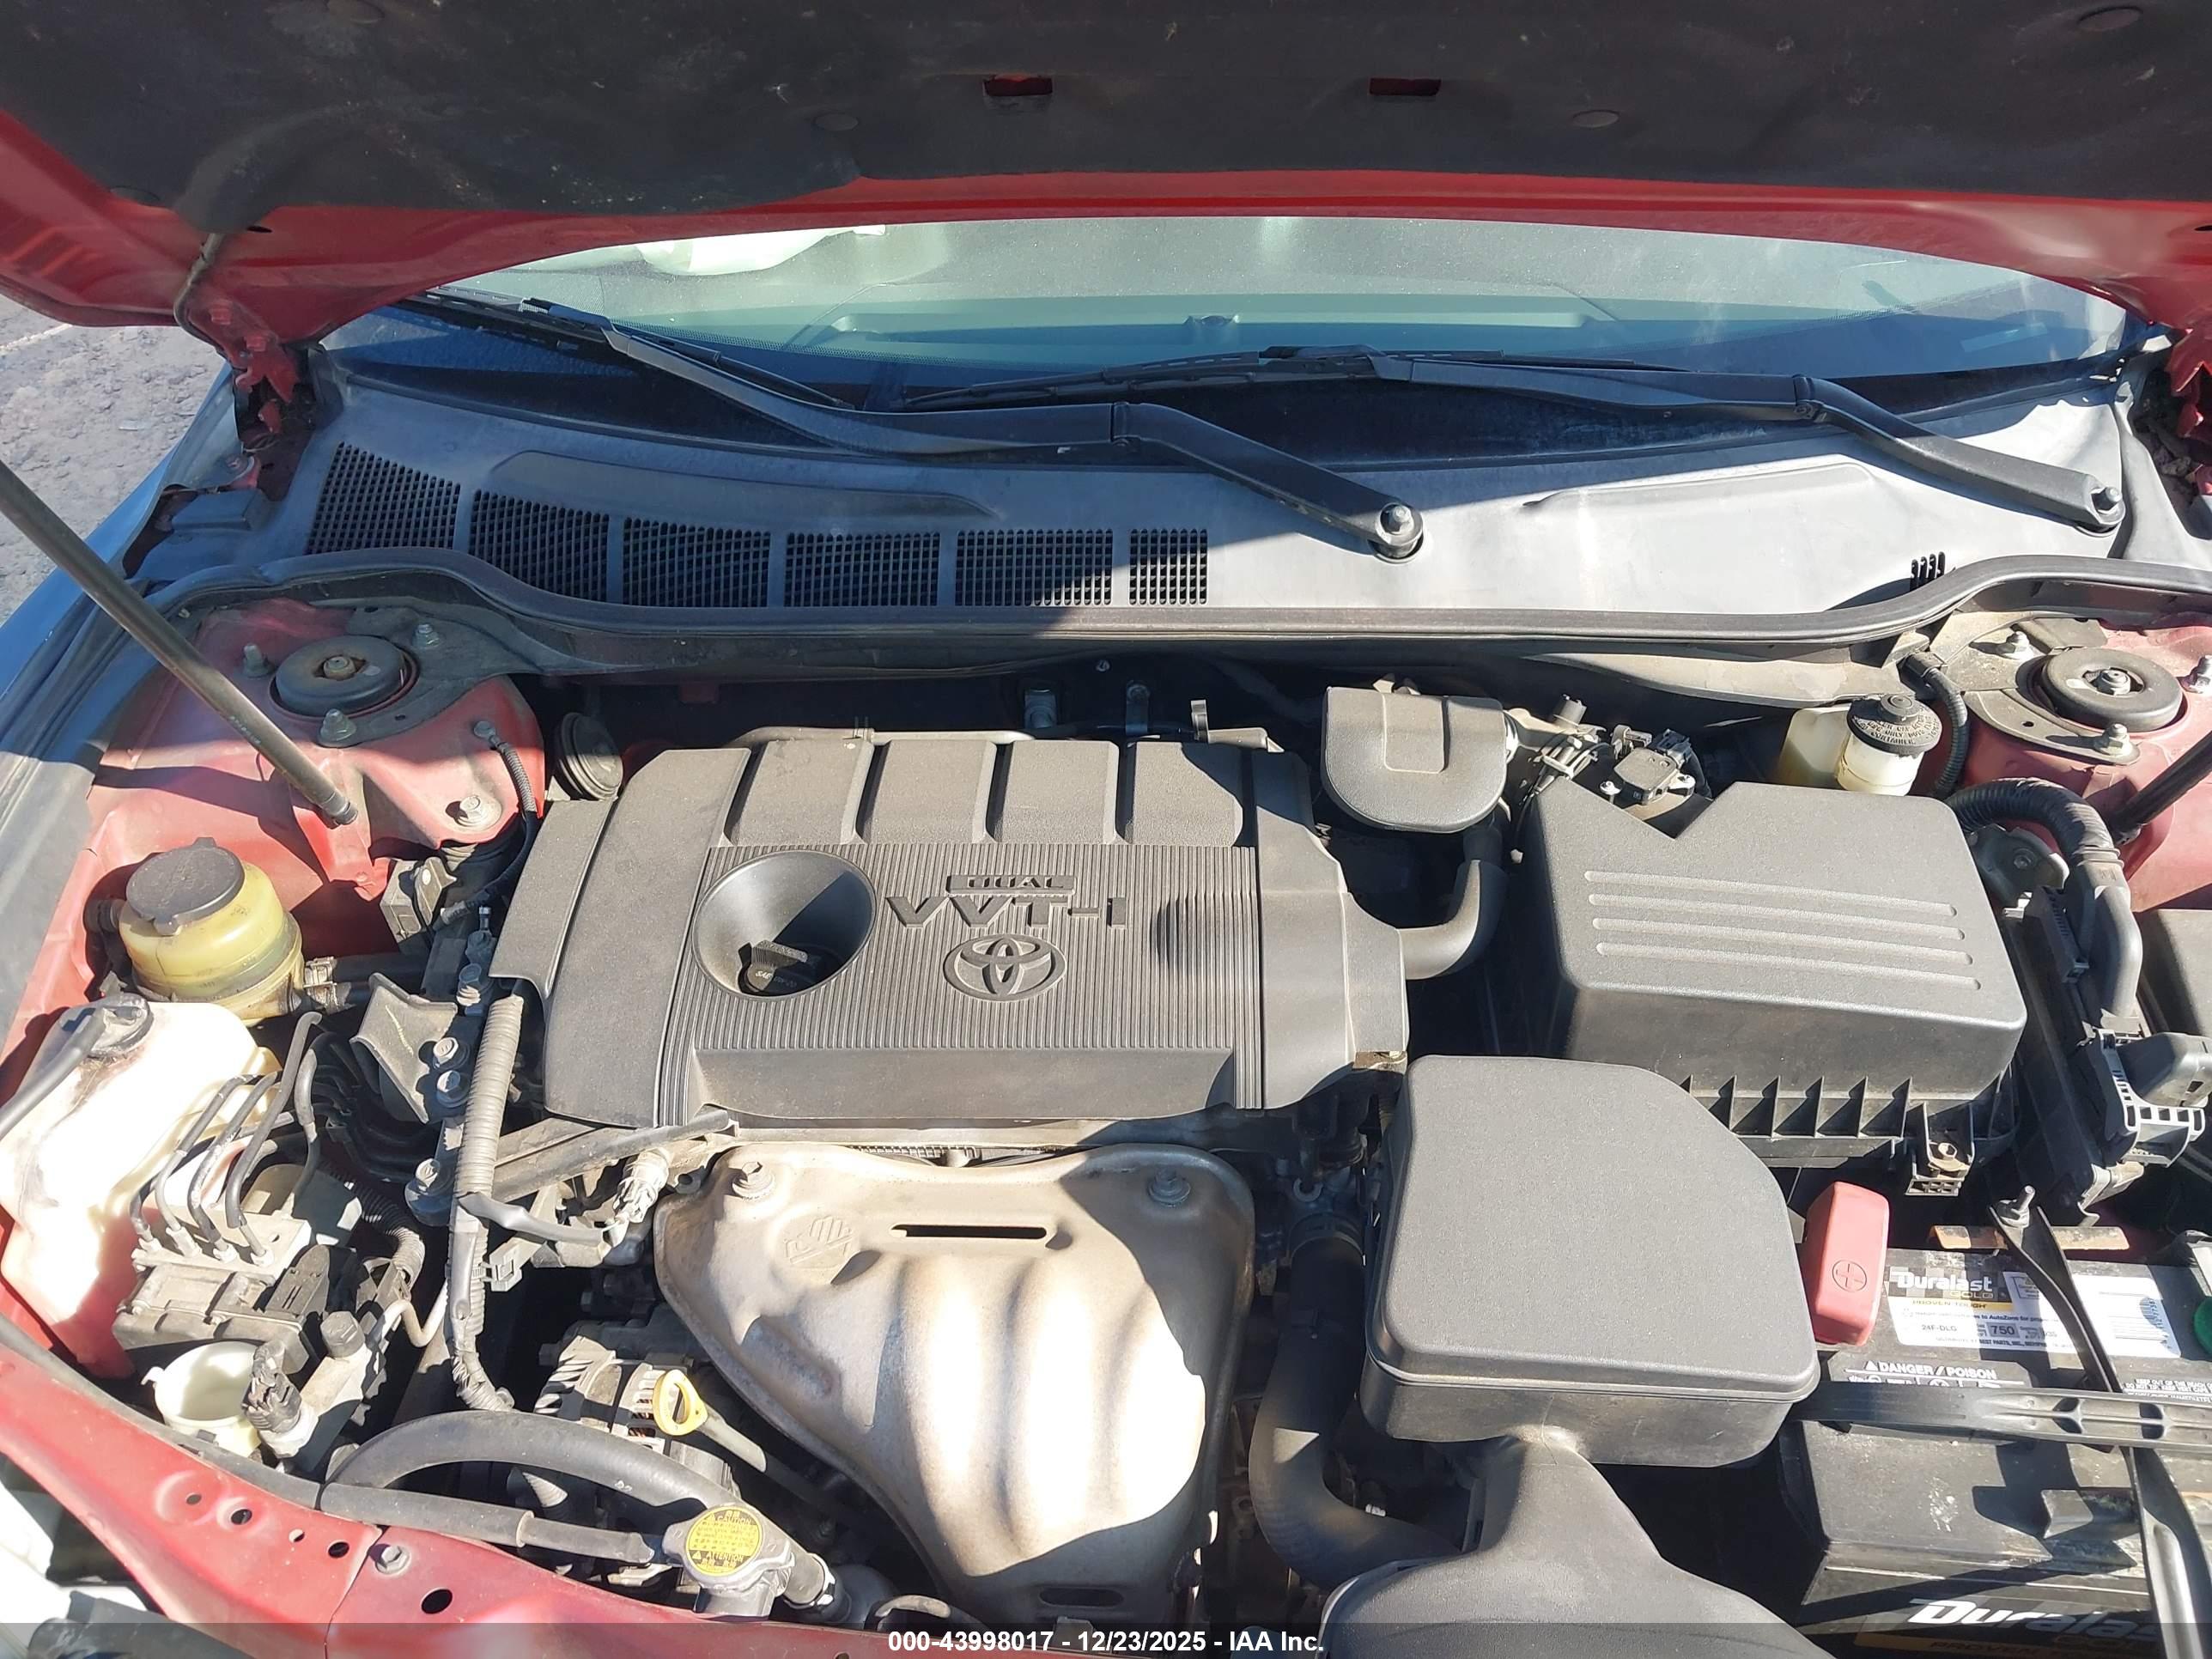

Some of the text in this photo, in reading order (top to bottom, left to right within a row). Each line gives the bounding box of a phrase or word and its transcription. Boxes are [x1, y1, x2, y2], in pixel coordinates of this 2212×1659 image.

[967, 876, 1066, 890] DUAL
[1890, 1270, 1993, 1292] Duralast
[1950, 1291, 1994, 1299] GOLD
[1990, 1325, 2015, 1335] 750
[1879, 1361, 1932, 1376] DANGER
[1946, 1366, 1998, 1380] POISON
[717, 1515, 751, 1525] CAUTION
